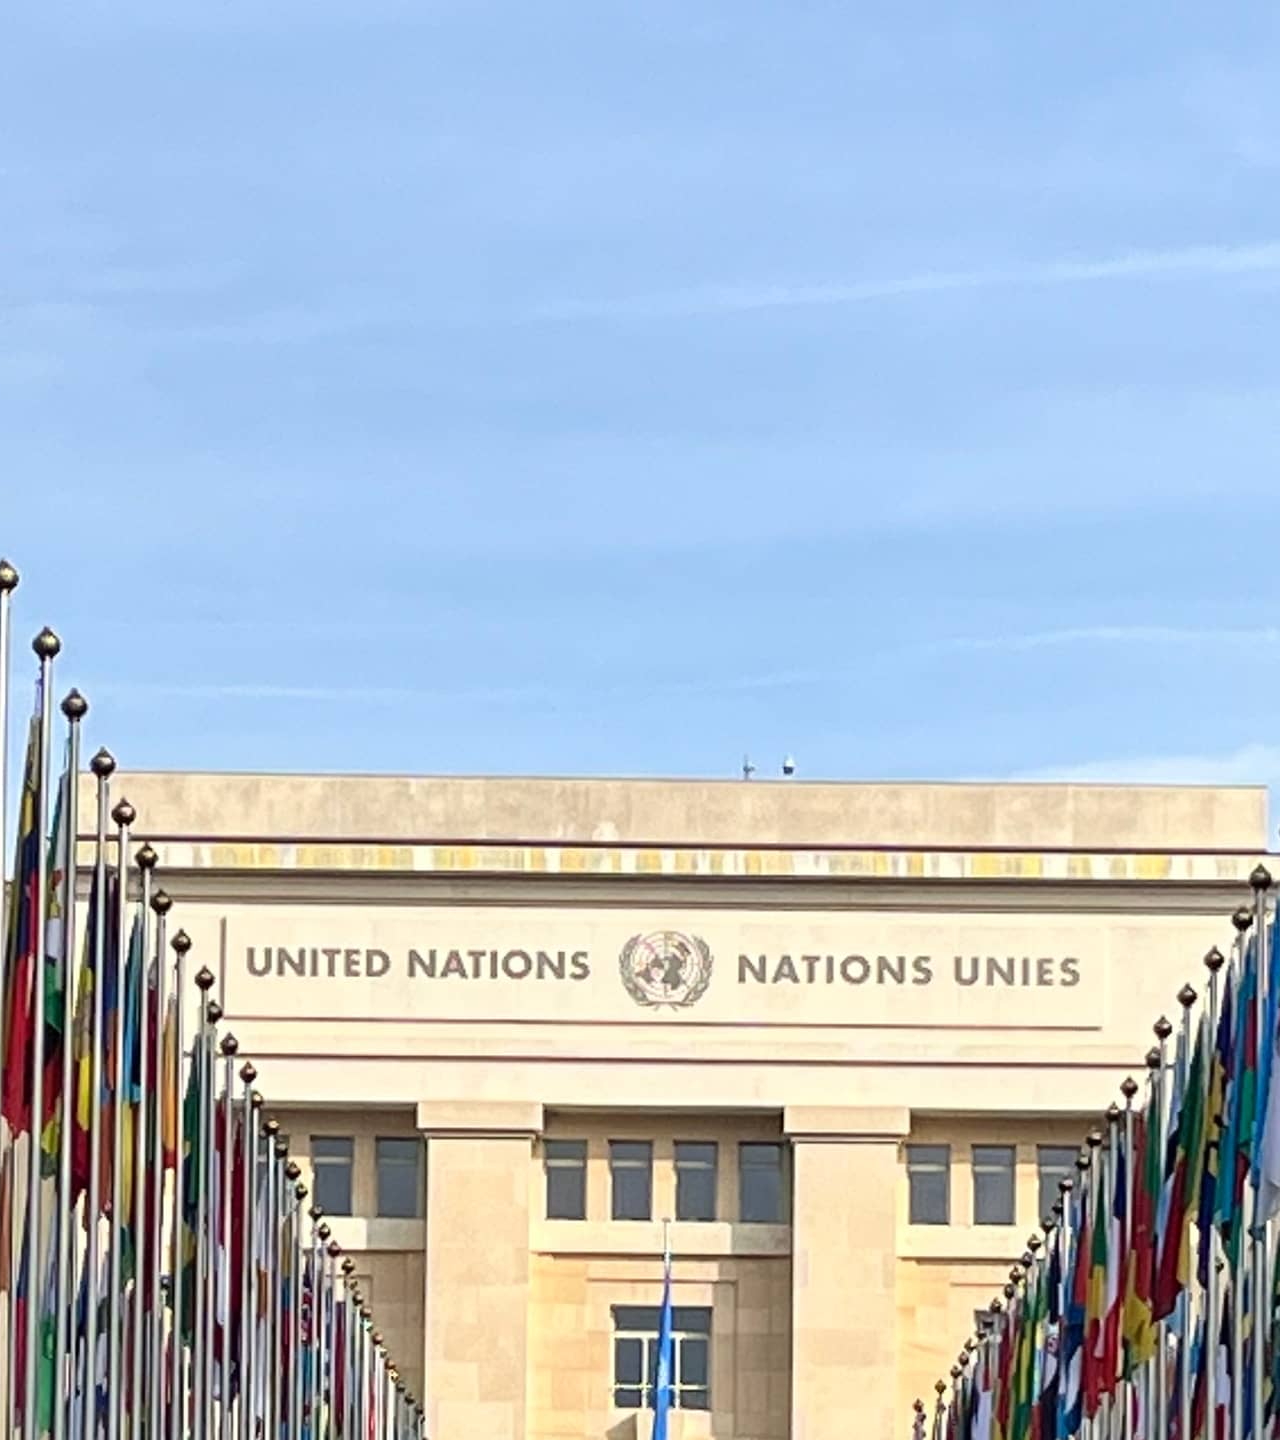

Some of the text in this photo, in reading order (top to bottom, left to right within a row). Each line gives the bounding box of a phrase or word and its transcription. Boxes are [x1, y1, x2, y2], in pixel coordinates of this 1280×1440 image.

[247, 947, 591, 981] UNITED NATIONS
[738, 954, 1082, 988] NATIONS UNIES
